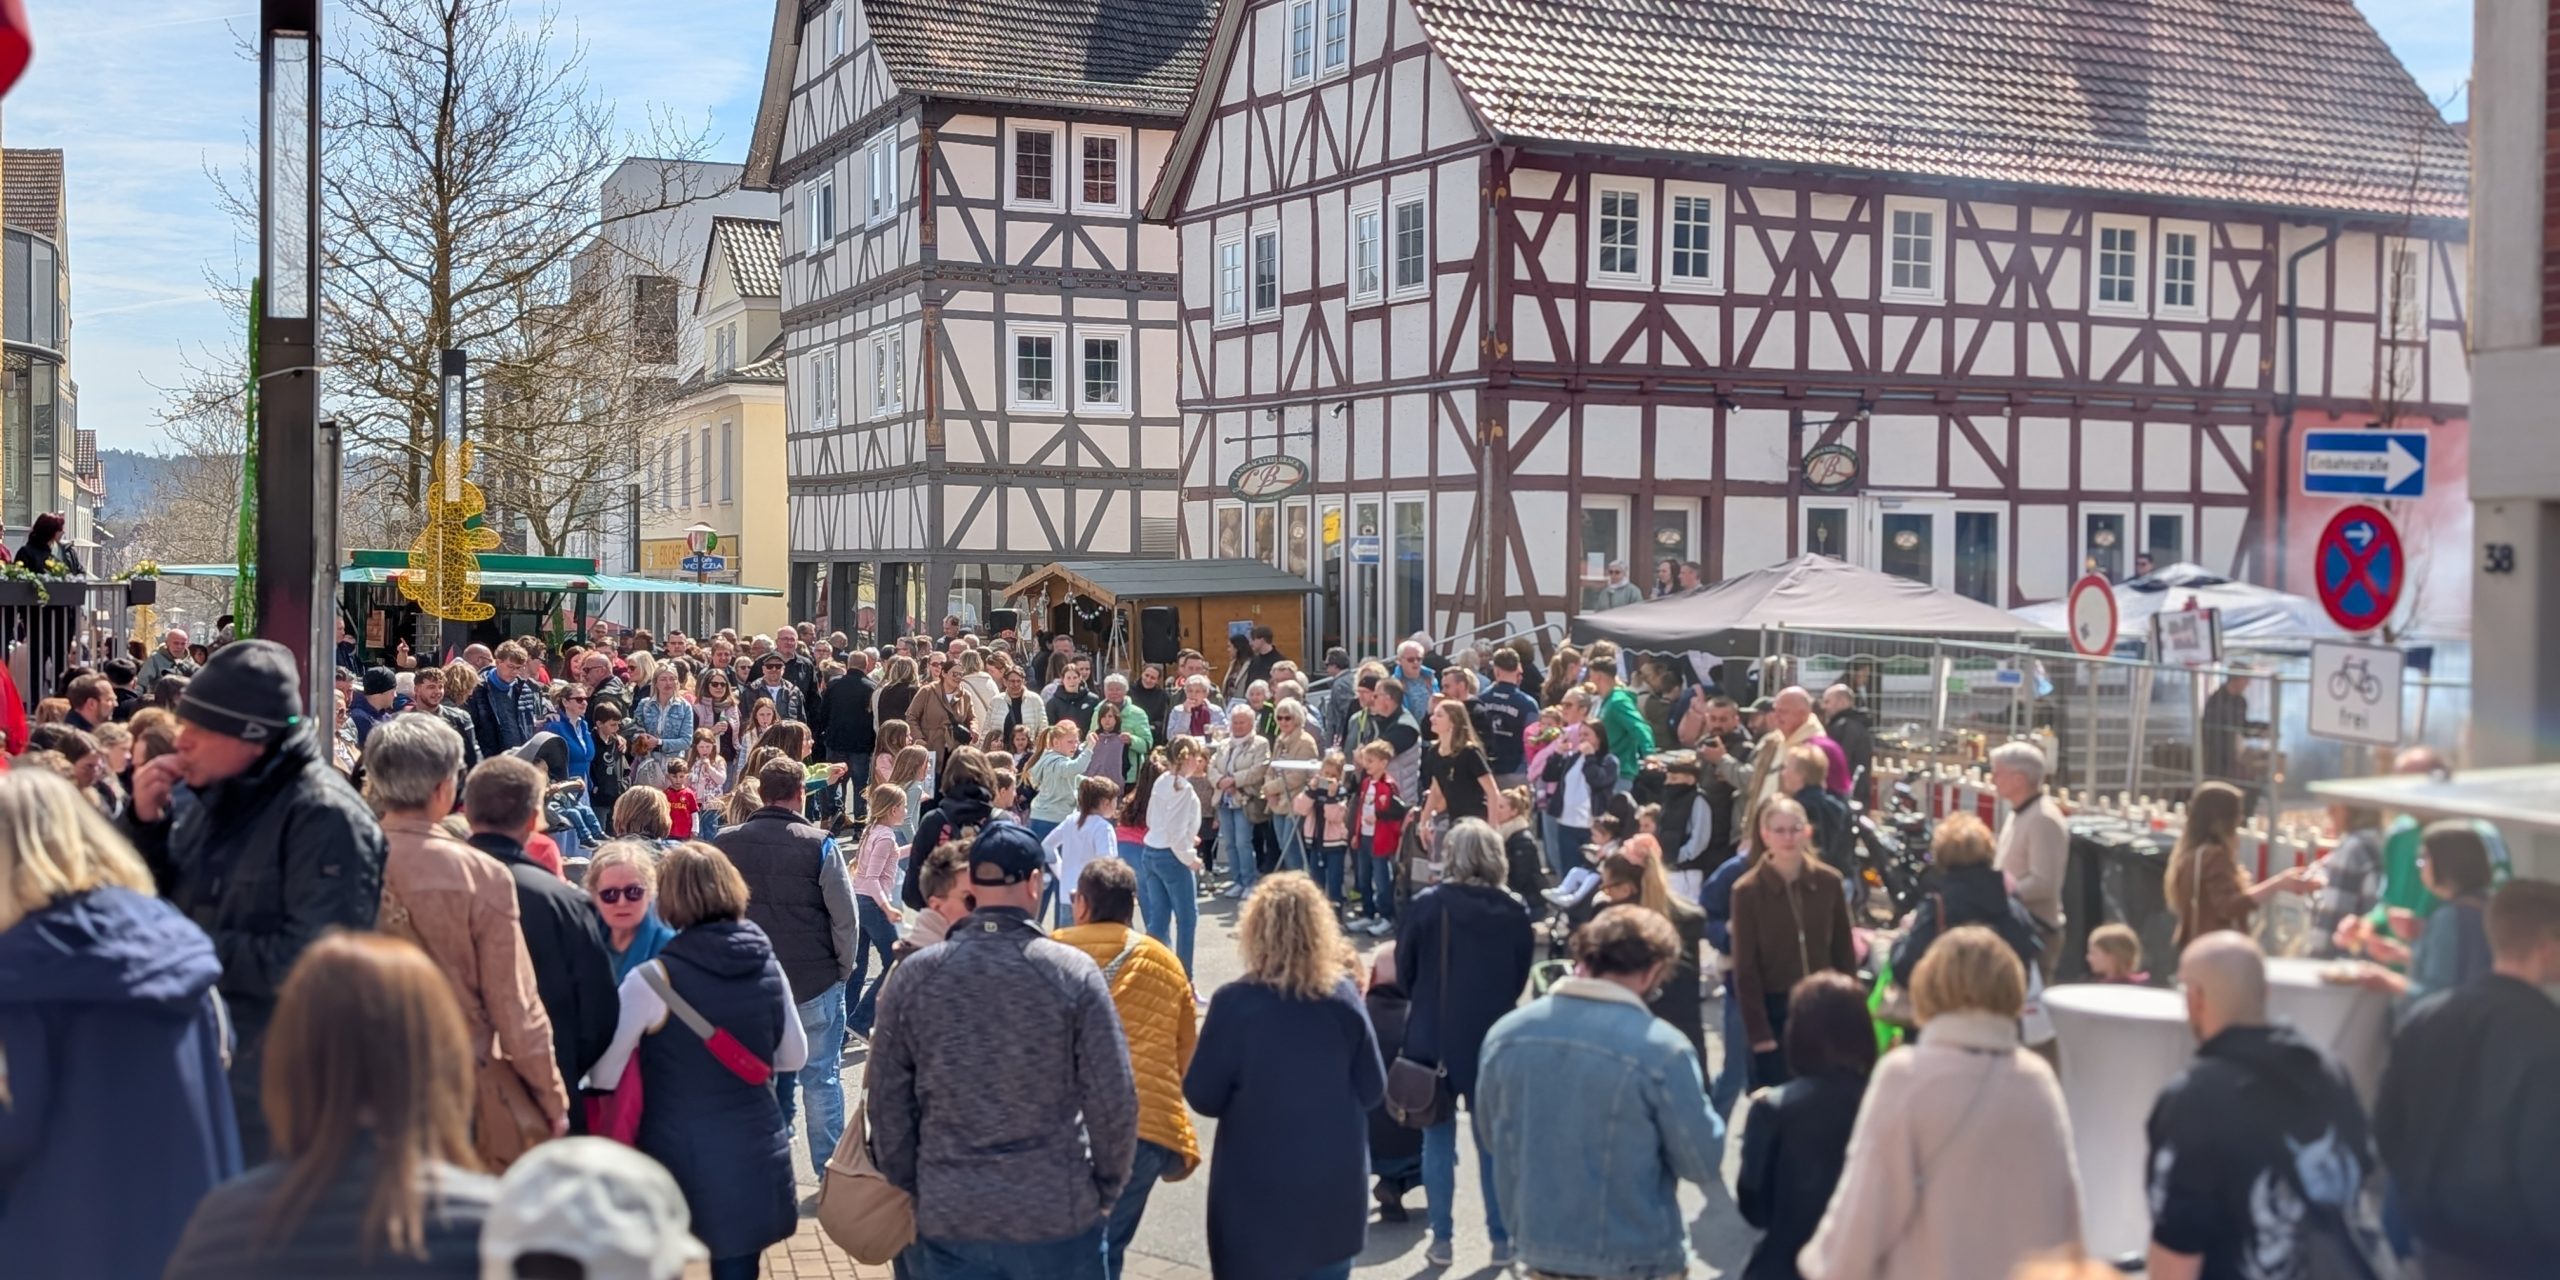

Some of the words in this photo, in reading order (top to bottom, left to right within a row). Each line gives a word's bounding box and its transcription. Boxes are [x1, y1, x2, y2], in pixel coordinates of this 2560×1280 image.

[2310, 454, 2389, 472] Einbahnstraße
[2484, 543, 2514, 574] 38
[2339, 706, 2369, 731] frei
